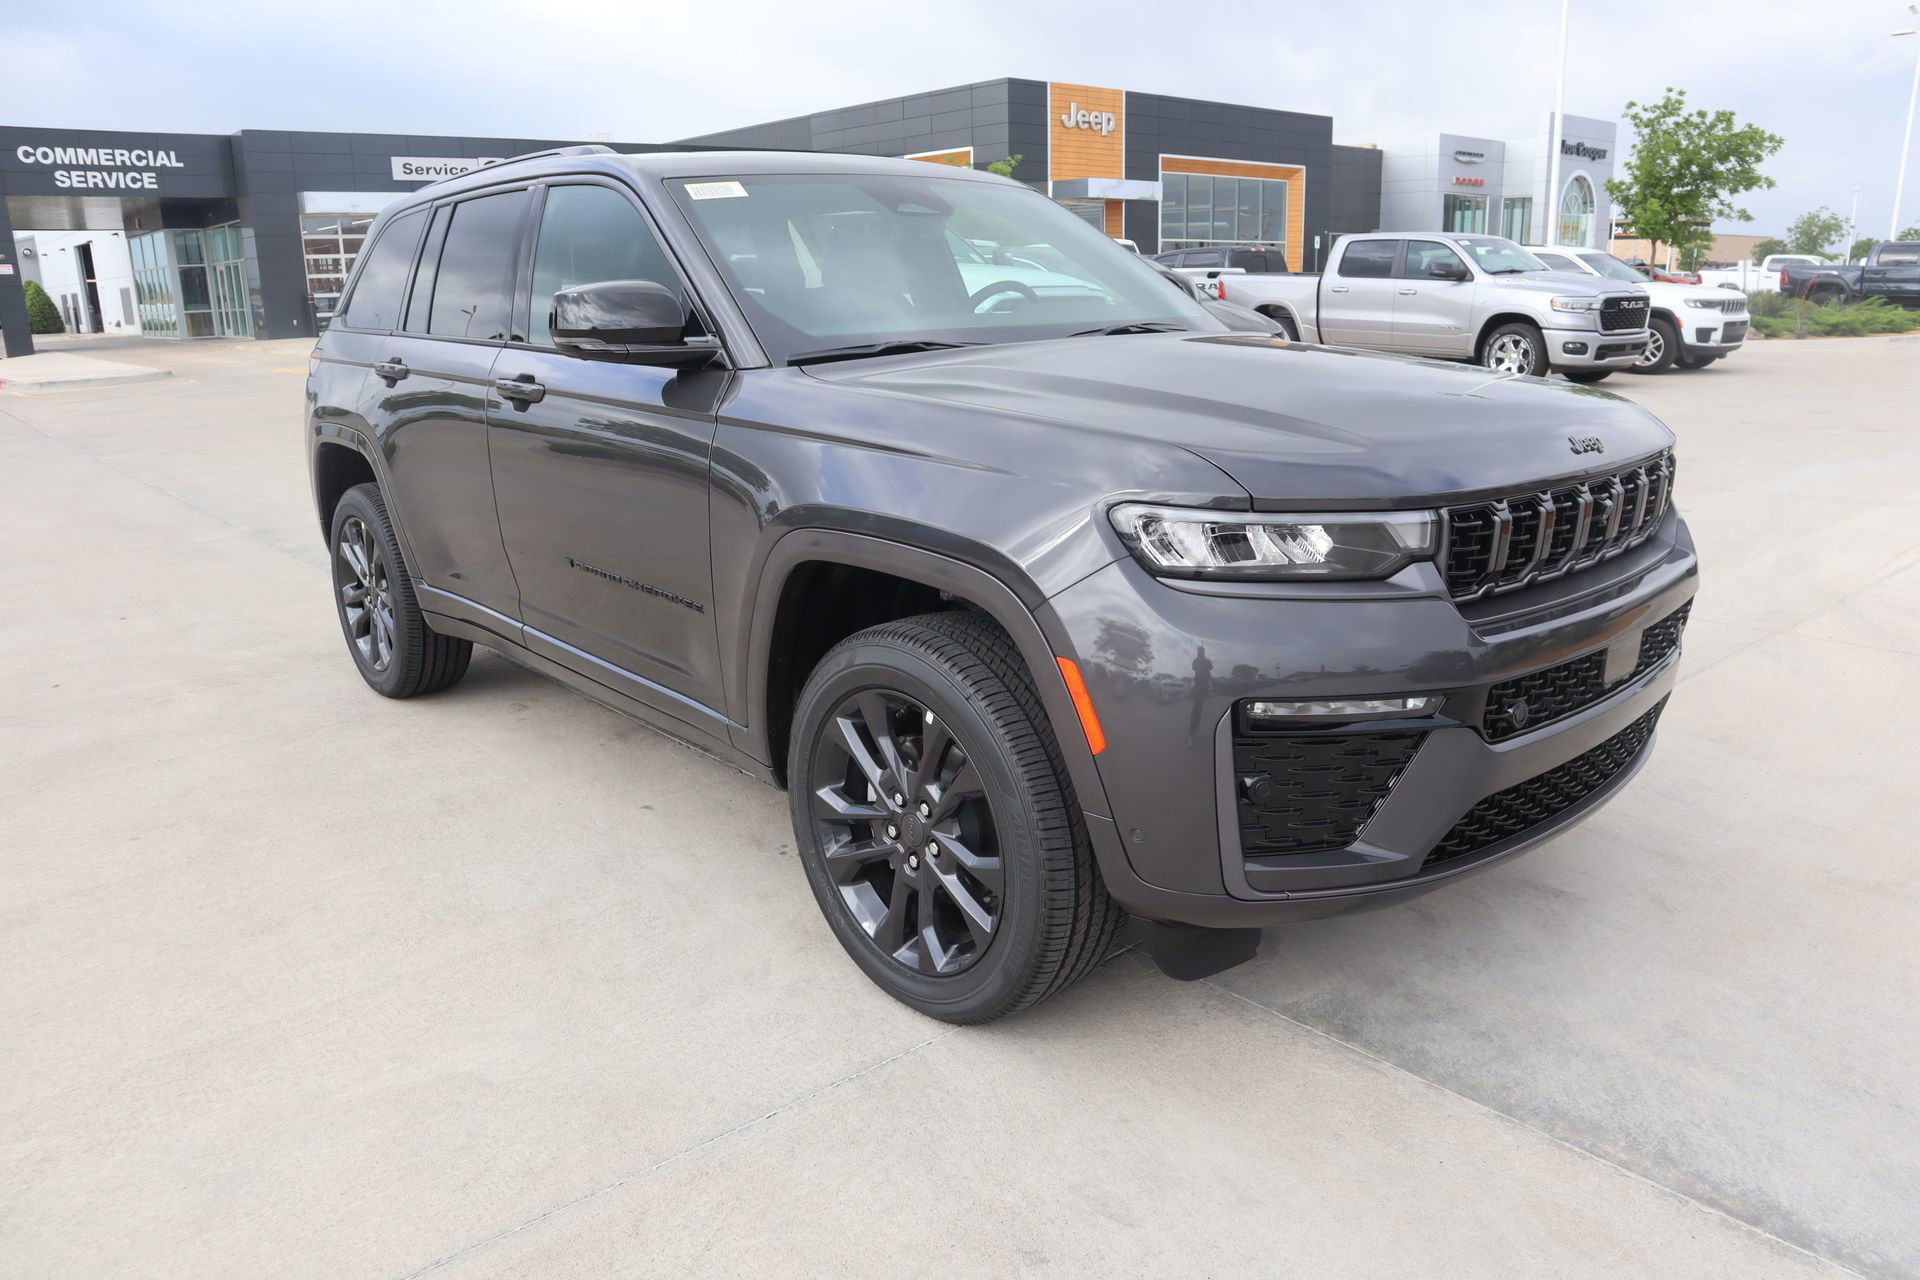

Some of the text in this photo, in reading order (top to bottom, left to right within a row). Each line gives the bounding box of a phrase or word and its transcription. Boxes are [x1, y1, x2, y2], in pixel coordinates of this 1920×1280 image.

[1061, 102, 1116, 136] Jeep
[16, 145, 184, 168] COMMERCIAL
[54, 170, 158, 189] SERVICE
[1568, 436, 1605, 455] Jeep
